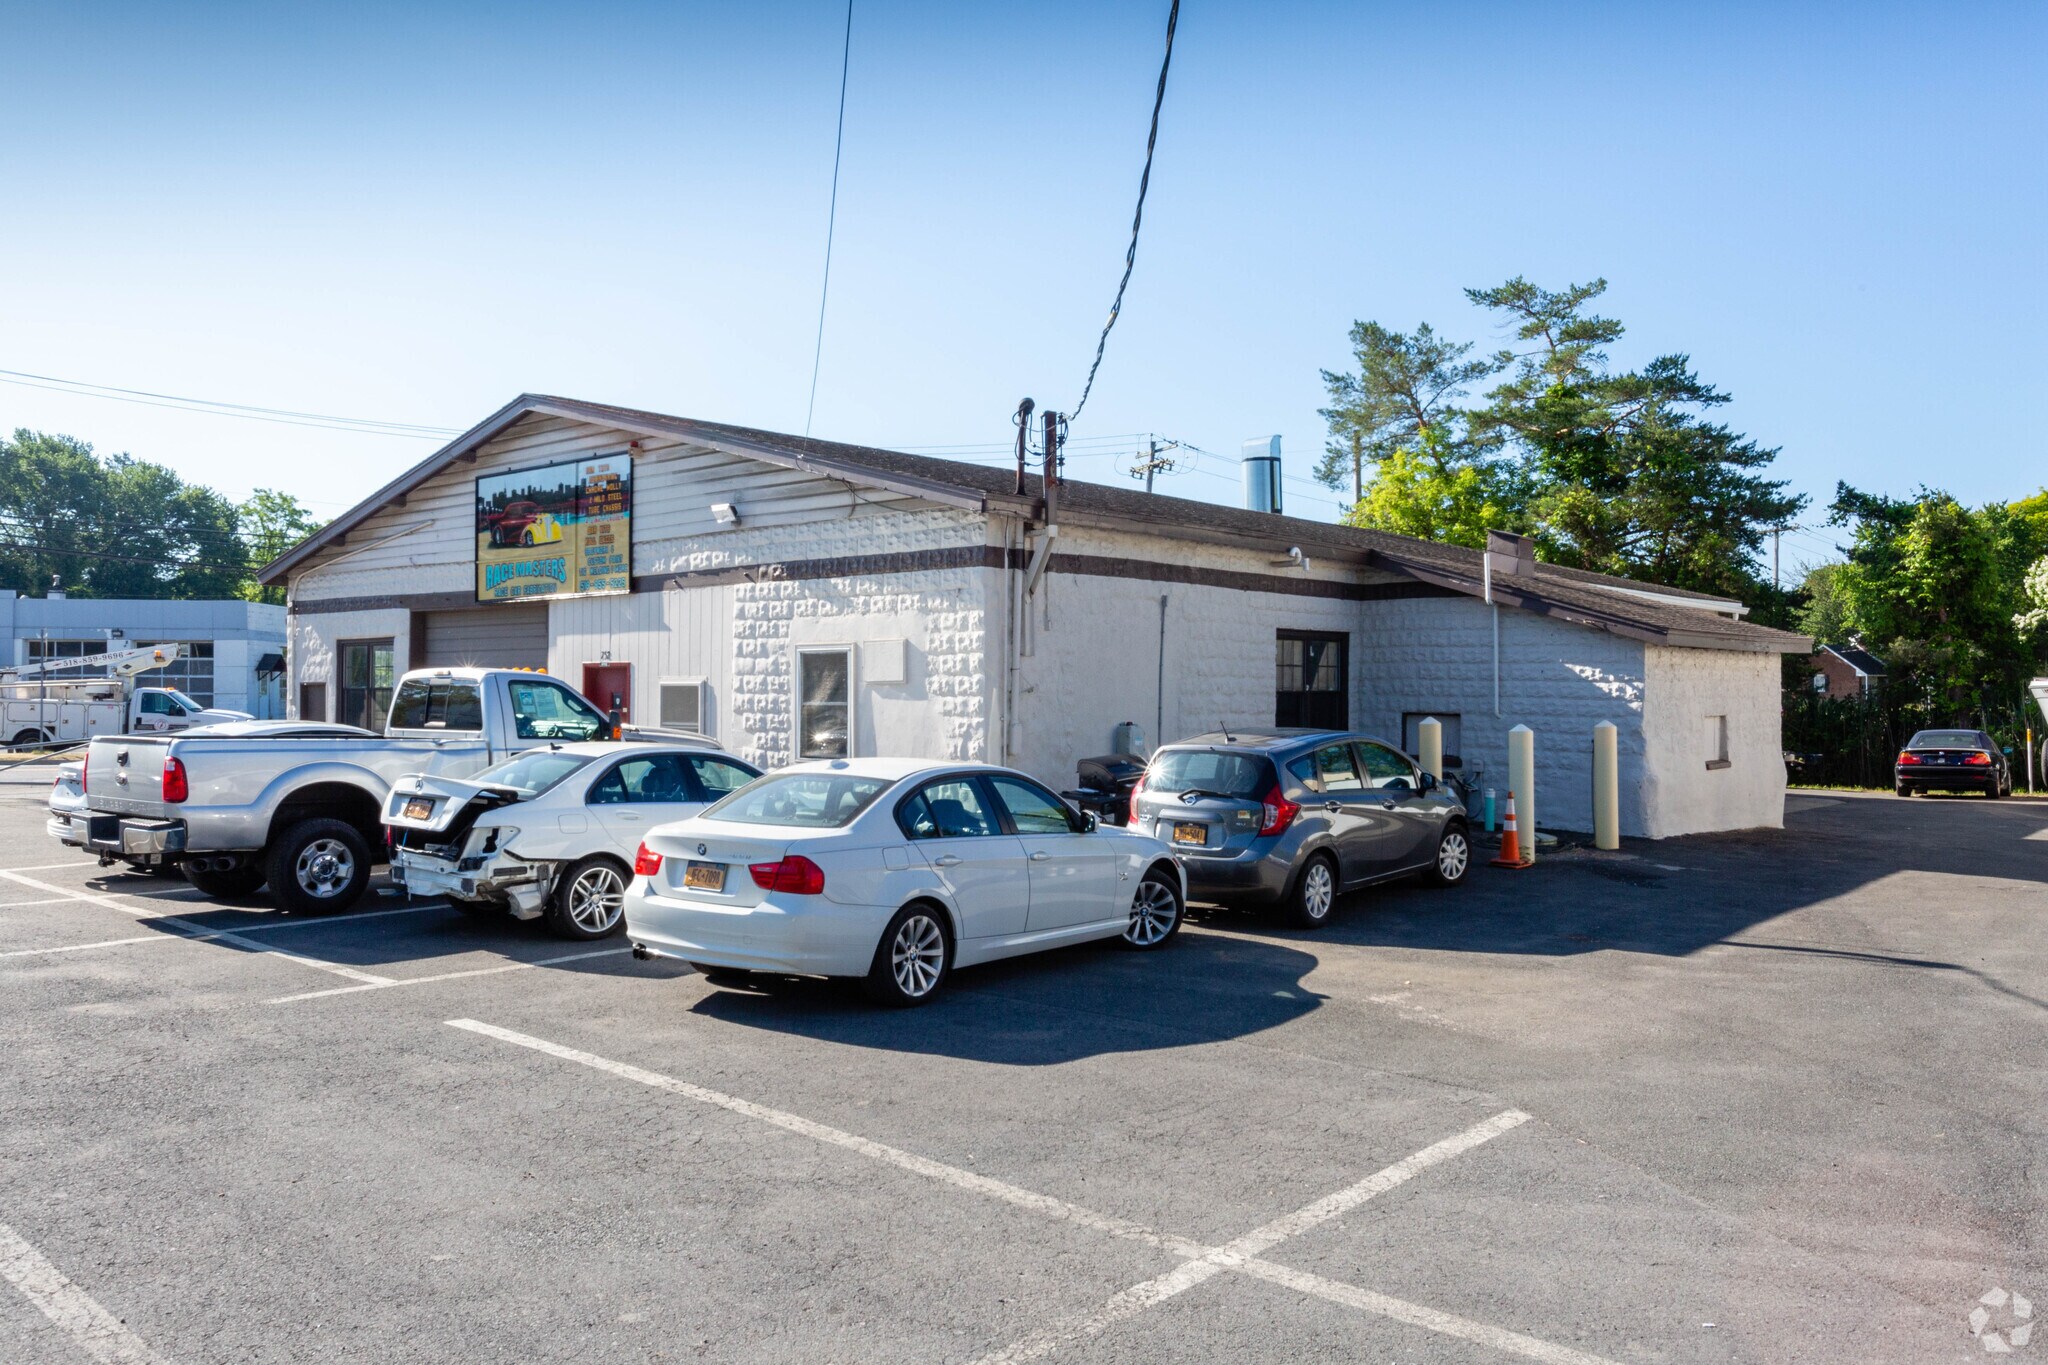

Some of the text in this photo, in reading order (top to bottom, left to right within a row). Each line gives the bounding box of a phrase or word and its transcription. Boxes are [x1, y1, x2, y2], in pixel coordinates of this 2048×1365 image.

[607, 492, 622, 501] STEEL
[602, 502, 622, 512] CHASSIS
[486, 556, 567, 591] RACE MASTERS
[494, 586, 508, 597] RACE
[63, 651, 124, 667] 518-859-9696
